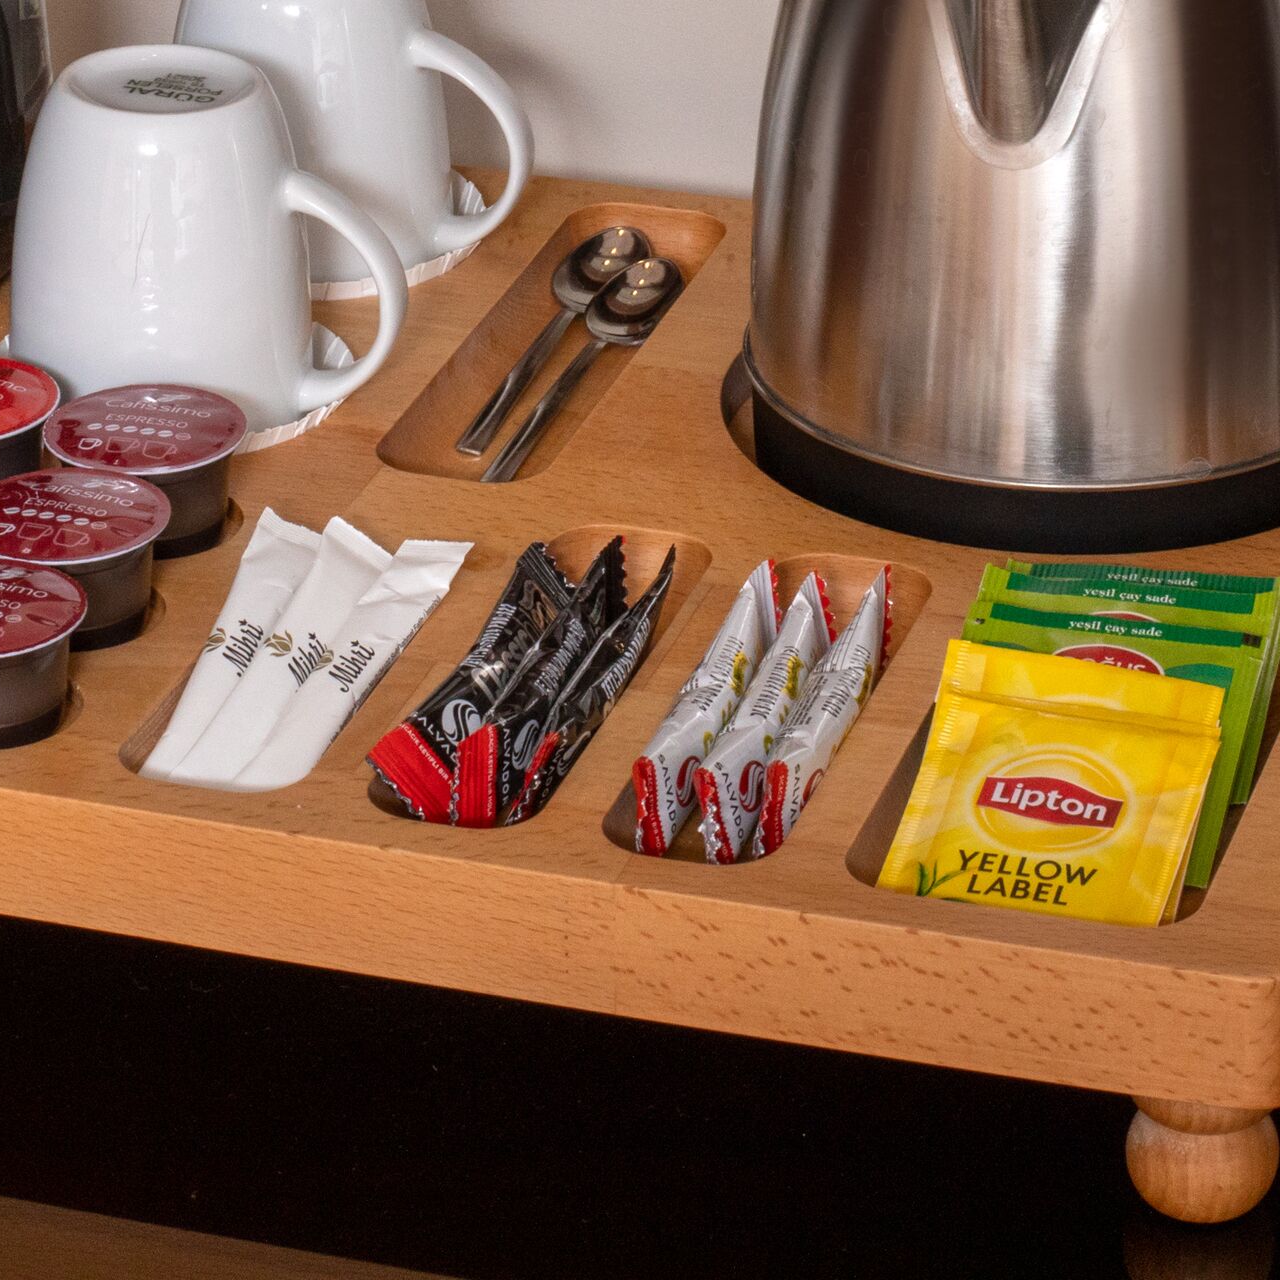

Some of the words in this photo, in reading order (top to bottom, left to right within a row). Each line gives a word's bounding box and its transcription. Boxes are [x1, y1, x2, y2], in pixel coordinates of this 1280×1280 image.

[123, 85, 216, 103] GÜRAL
[105, 399, 212, 419] Cafissimo
[105, 413, 188, 429] ESPRESSO
[30, 482, 135, 508] Cafissimo
[23, 496, 108, 517] ESPRESSO
[1167, 578, 1199, 587] sade
[1082, 588, 1116, 598] yeşil
[1119, 593, 1142, 602] çay
[1145, 594, 1177, 605] sade
[1067, 620, 1102, 632] yeşil
[1104, 624, 1128, 635] çay
[1130, 627, 1163, 637] sade
[657, 754, 677, 834] SALVADO
[714, 761, 744, 840] SALVADO
[990, 781, 1108, 822] Lipton
[959, 849, 1099, 887] YELLOW
[966, 873, 1069, 906] LABEL
